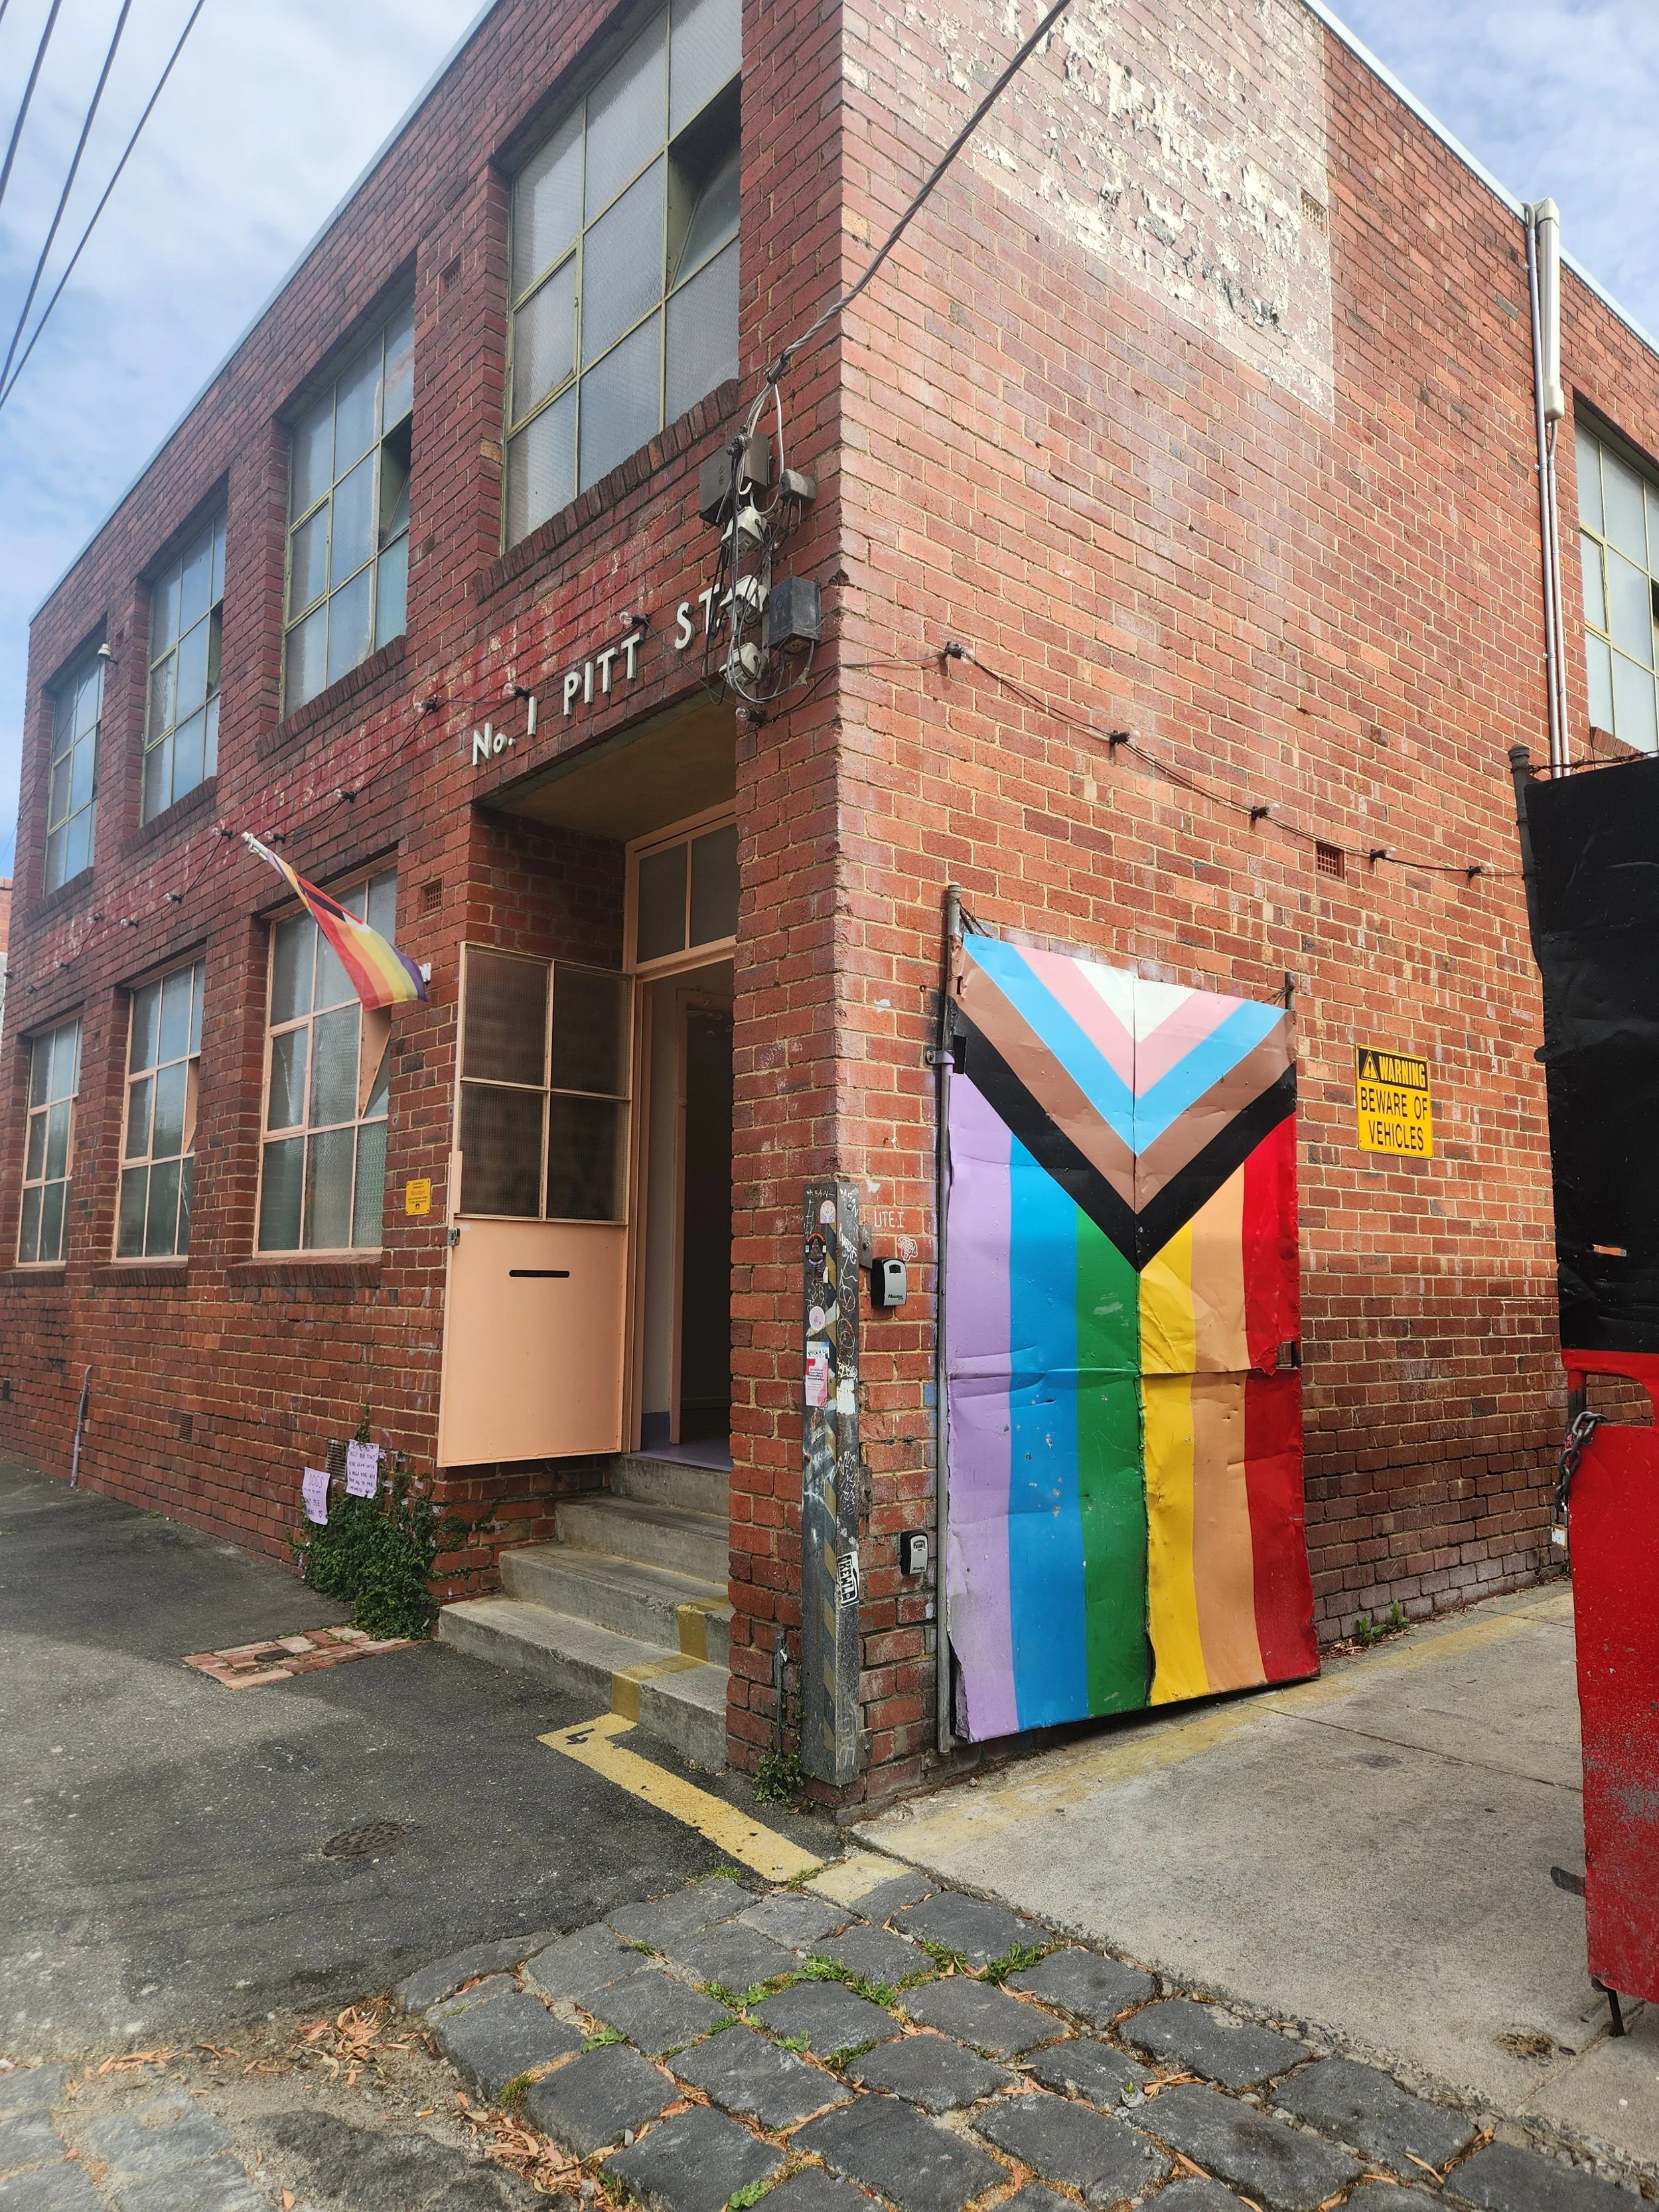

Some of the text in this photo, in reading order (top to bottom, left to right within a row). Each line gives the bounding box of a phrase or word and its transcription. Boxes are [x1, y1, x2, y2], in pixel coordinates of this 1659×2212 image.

[472, 722, 516, 766] No.
[563, 632, 644, 716] PITT
[1378, 1056, 1425, 1088] WARNING
[1362, 1087, 1428, 1120] BEWARE OF
[1368, 1120, 1425, 1151] VEHICLES
[309, 1474, 324, 1489] DOGS
[839, 1560, 854, 1594] KEWL
